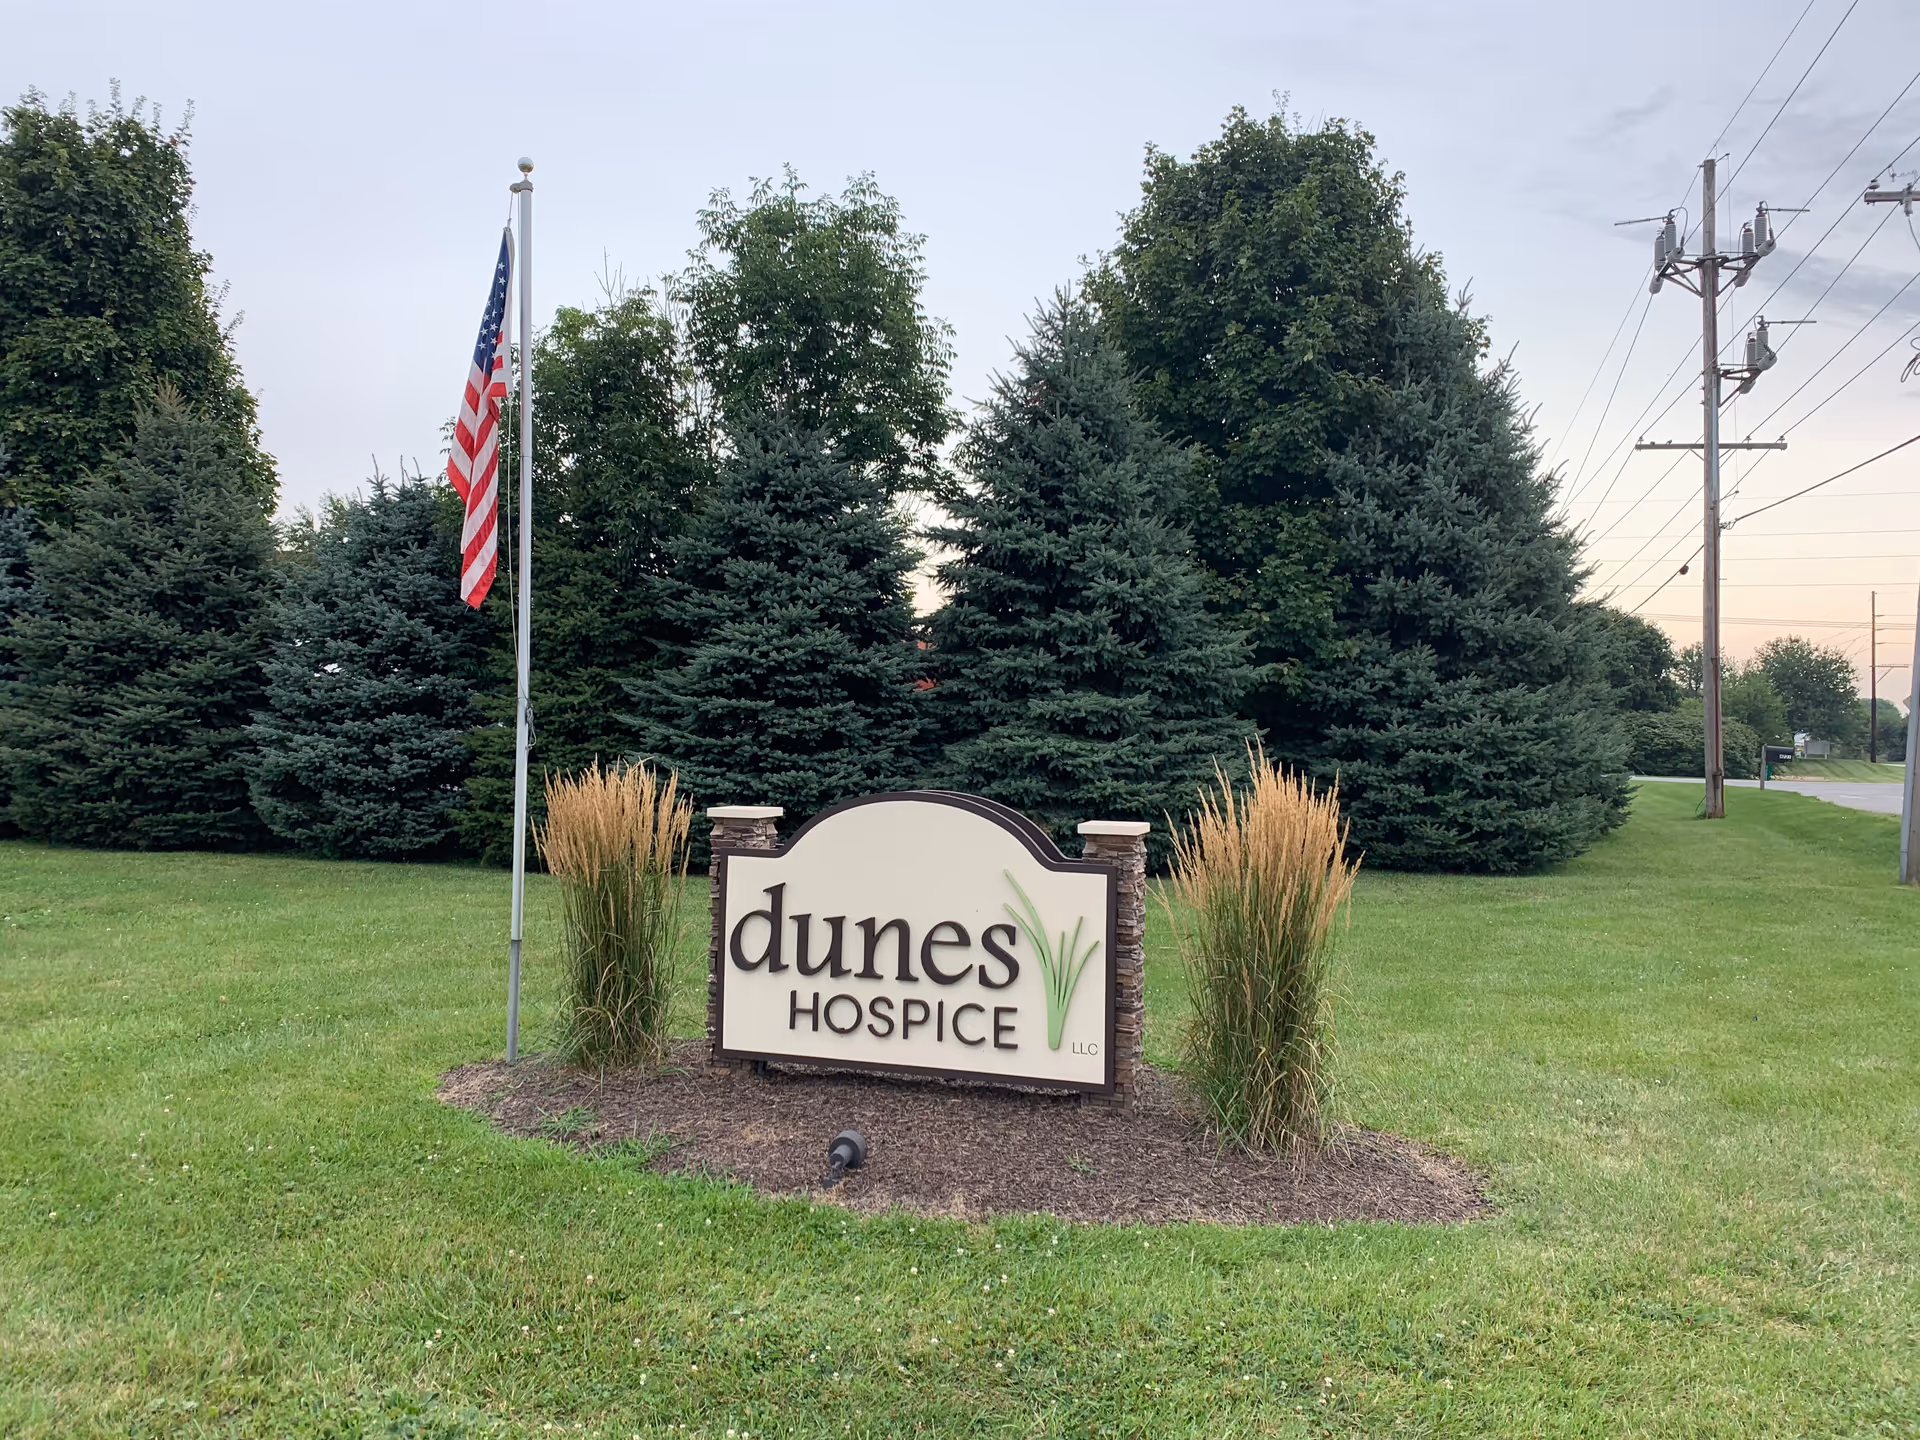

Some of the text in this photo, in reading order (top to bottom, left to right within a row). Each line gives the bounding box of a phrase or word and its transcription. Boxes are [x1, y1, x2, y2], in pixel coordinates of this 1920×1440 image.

[729, 882, 1020, 990] dunes
[789, 989, 1019, 1050] HOSPICE
[1072, 1041, 1099, 1057] LLC
